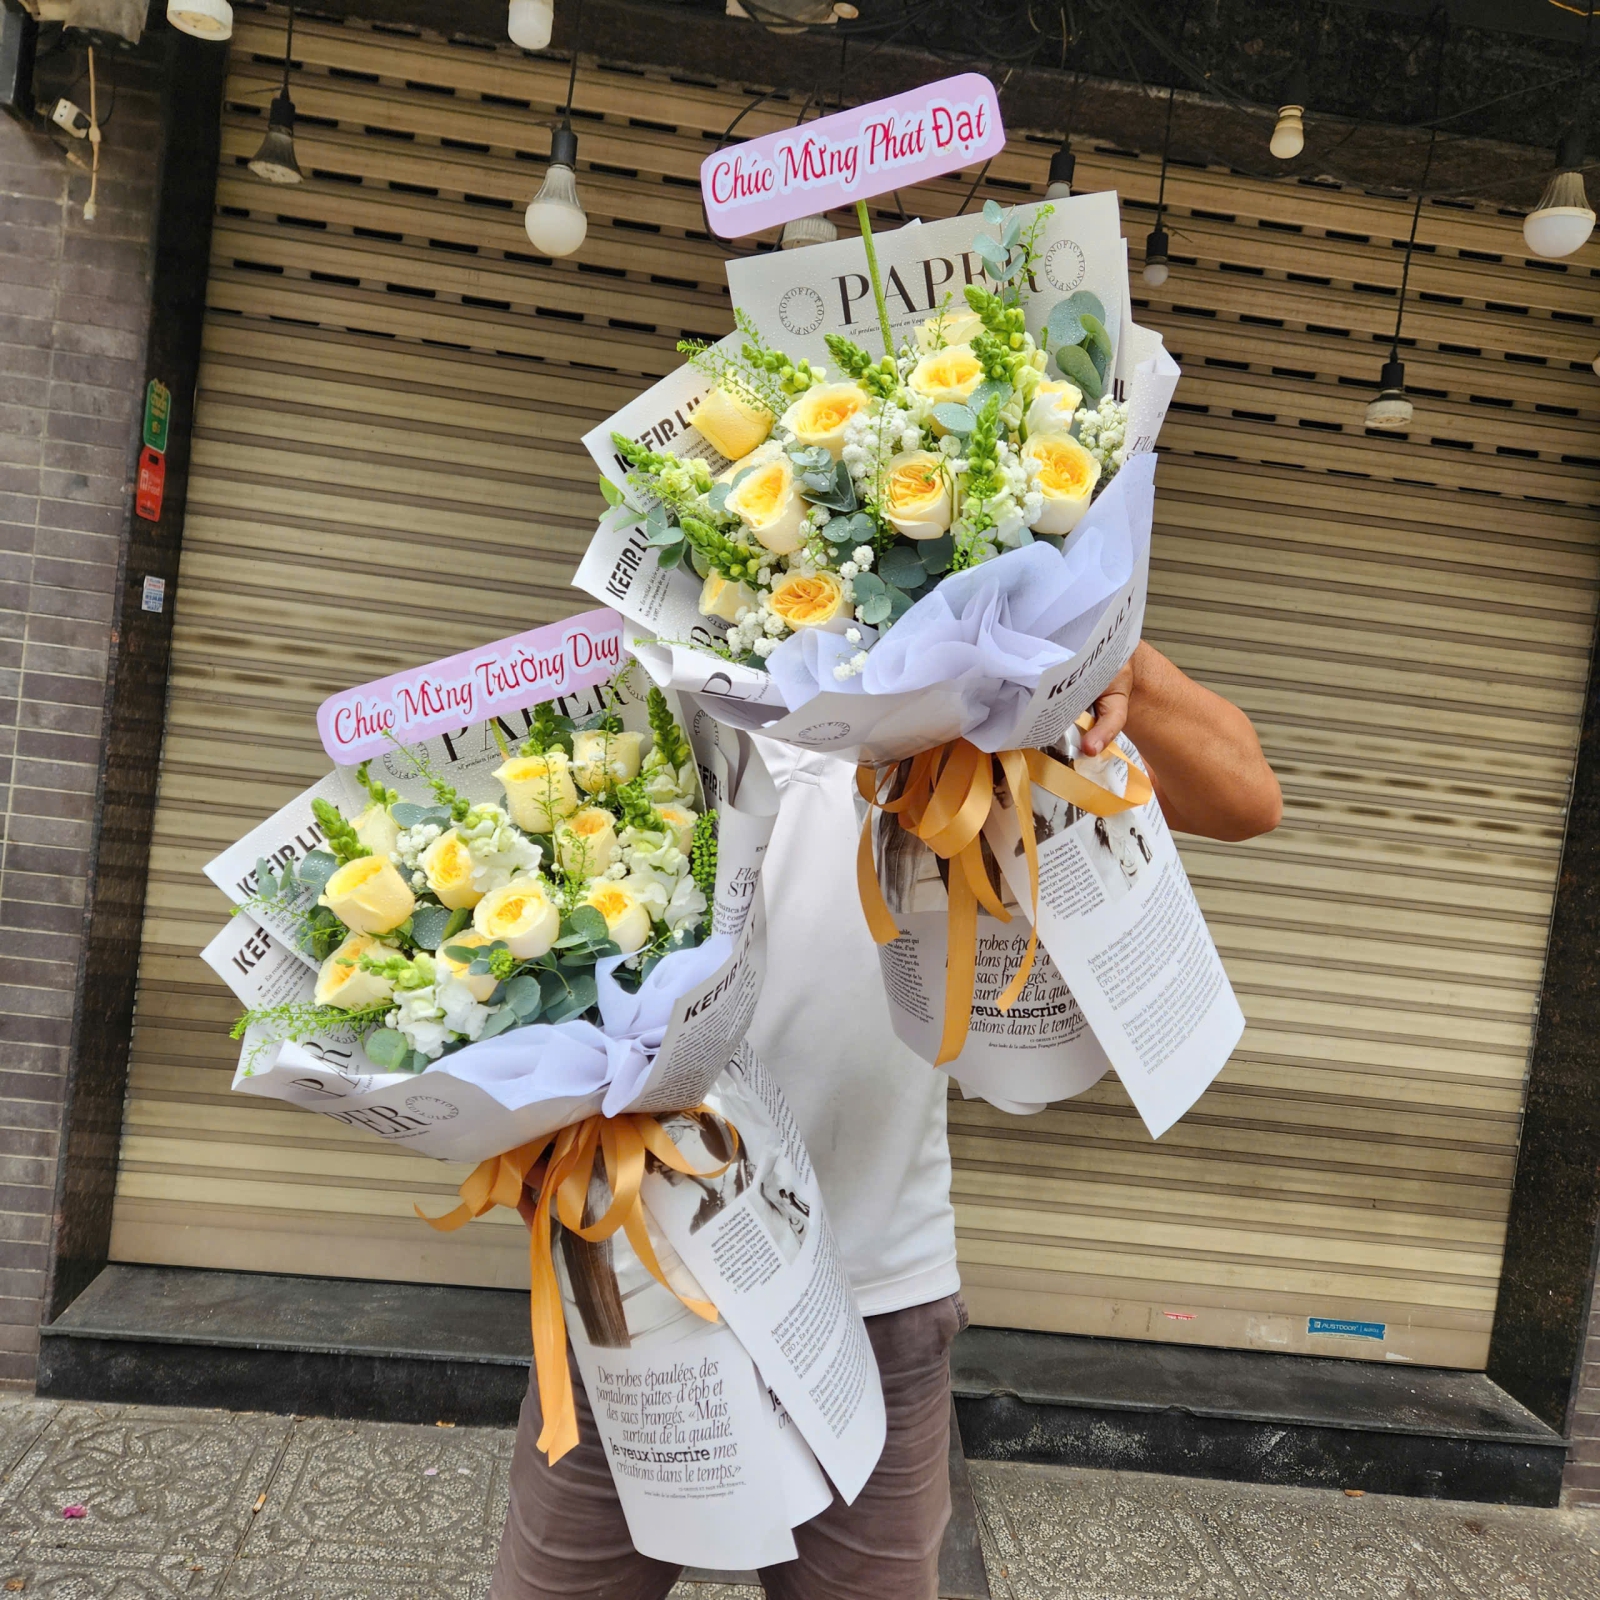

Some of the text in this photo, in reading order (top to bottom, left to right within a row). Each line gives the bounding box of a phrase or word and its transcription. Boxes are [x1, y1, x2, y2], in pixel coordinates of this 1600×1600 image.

[711, 103, 987, 204] Chúc Mừng Phát Đạt
[334, 632, 620, 744] Chúc Mừng Trường Duy
[979, 934, 1009, 951] robes
[976, 971, 998, 984] sacs
[1100, 976, 1113, 988] UFO
[1017, 985, 1032, 1002] de
[1034, 985, 1046, 1001] la
[1007, 1003, 1067, 1018] inscrire
[1007, 1019, 1036, 1035] dans
[1039, 1018, 1049, 1035] le
[597, 1357, 719, 1391] Des robes épaulées, des
[713, 1379, 723, 1397] et
[606, 1402, 618, 1421] des
[620, 1411, 639, 1425] sacs
[640, 1405, 685, 1430] frangés.
[622, 1417, 733, 1448] surtout de la qualité.
[620, 1445, 651, 1463] veux
[651, 1446, 710, 1463] inscrire
[713, 1443, 738, 1460] mes
[617, 1460, 654, 1481] créations
[657, 1465, 682, 1483] dans
[685, 1464, 694, 1483] le
